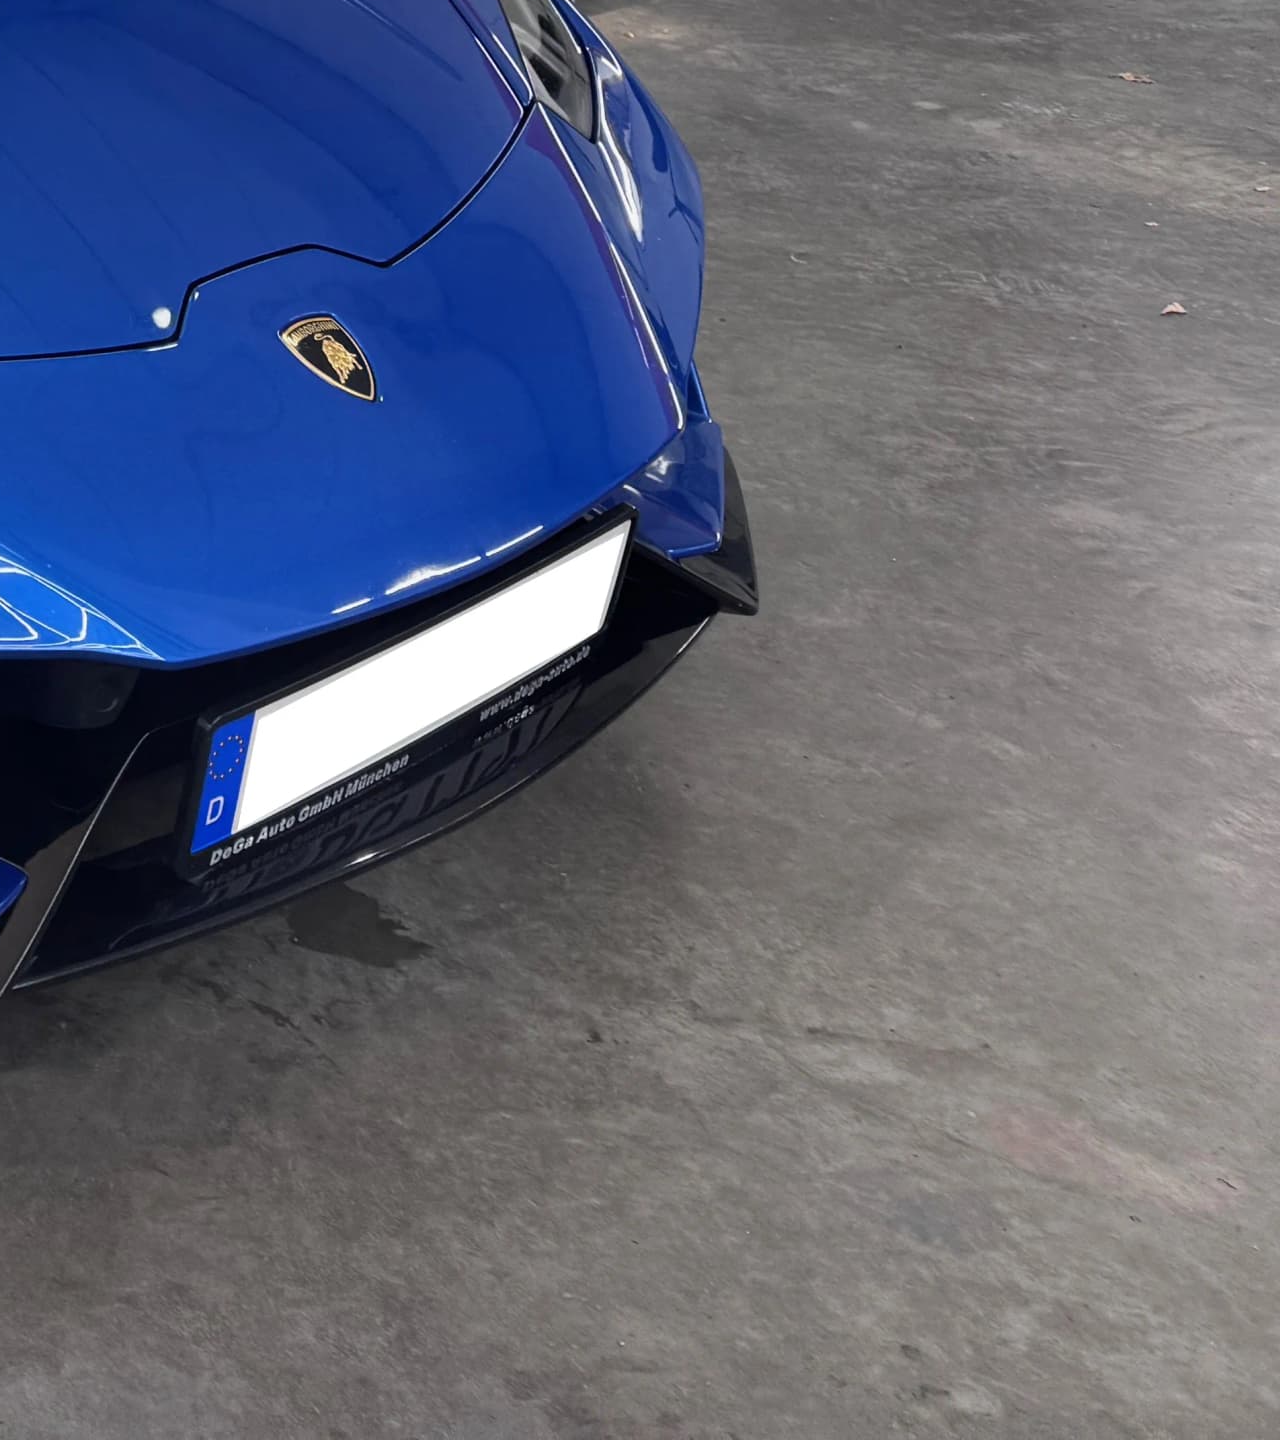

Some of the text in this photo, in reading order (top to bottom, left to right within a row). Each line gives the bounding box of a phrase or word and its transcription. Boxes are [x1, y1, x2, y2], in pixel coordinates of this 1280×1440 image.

[205, 796, 225, 826] D
[255, 816, 296, 845] Auto
[297, 788, 344, 824] GmbH
[345, 754, 410, 799] München
